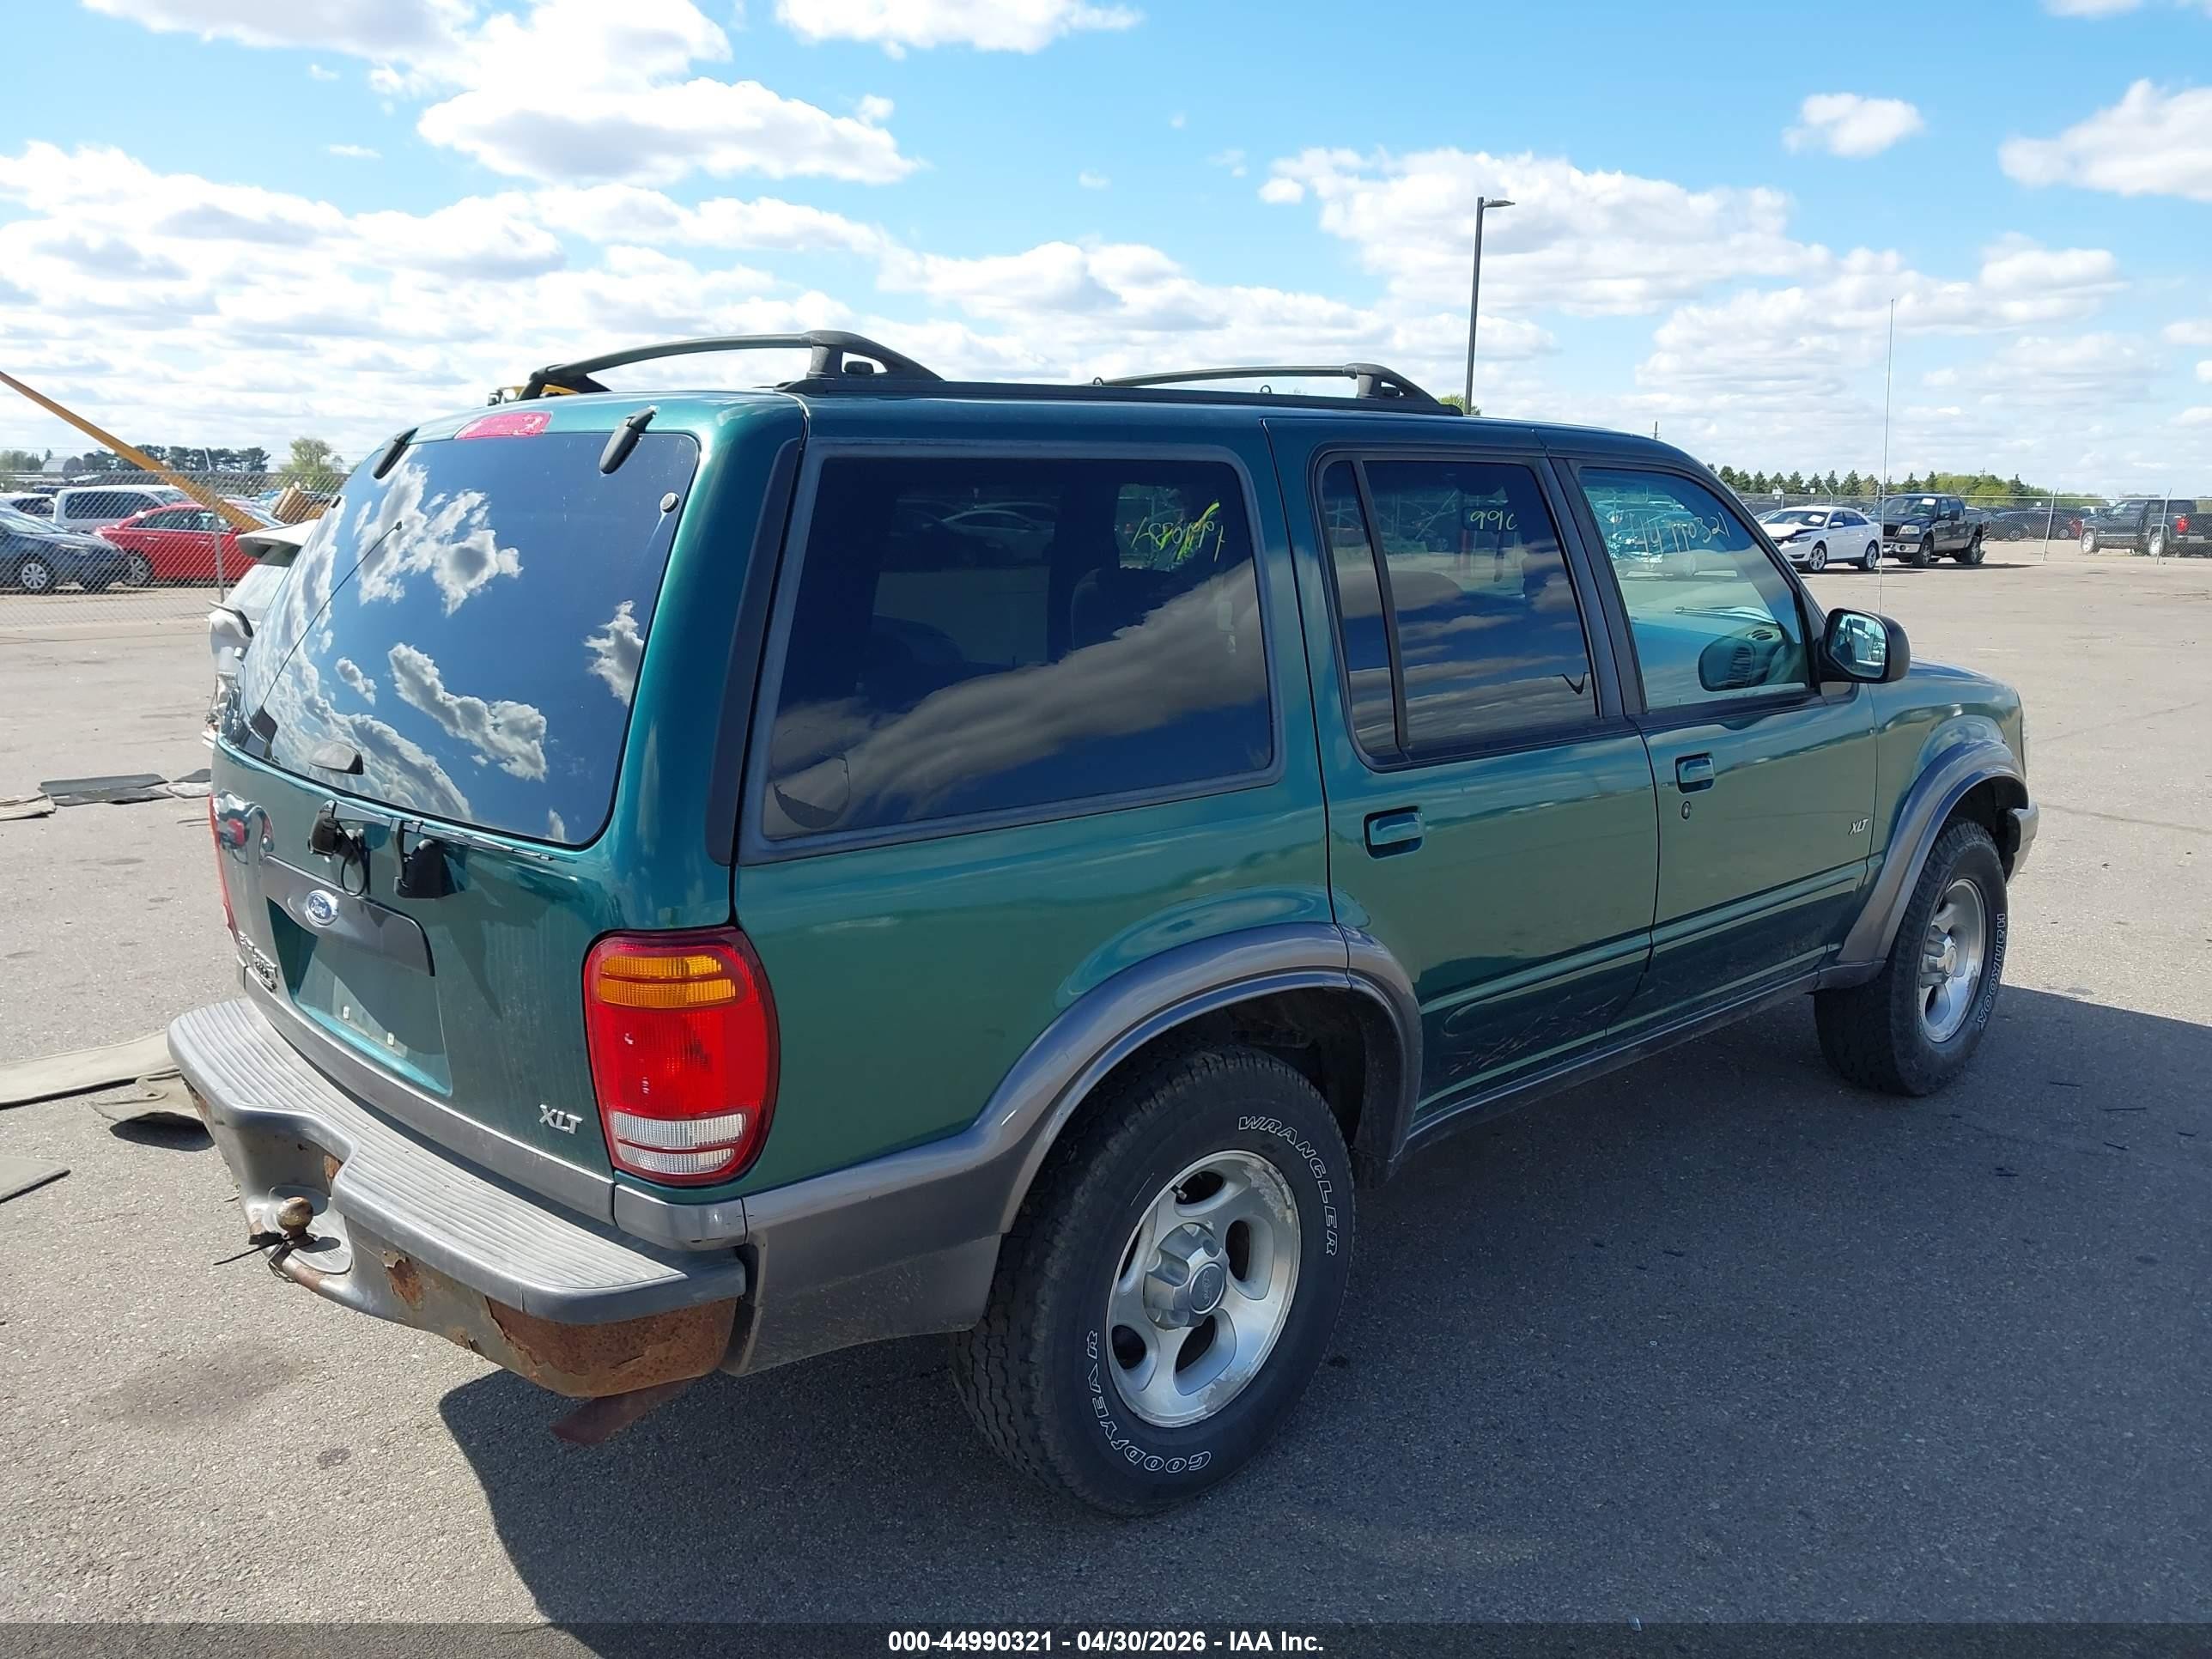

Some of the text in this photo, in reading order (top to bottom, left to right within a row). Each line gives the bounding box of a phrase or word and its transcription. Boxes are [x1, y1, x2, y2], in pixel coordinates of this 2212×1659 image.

[1849, 817, 1869, 836] XLT
[540, 1103, 584, 1134] XLT
[1238, 1116, 1339, 1257] WRANGLER
[1086, 1330, 1212, 1474] GOODYEAR
